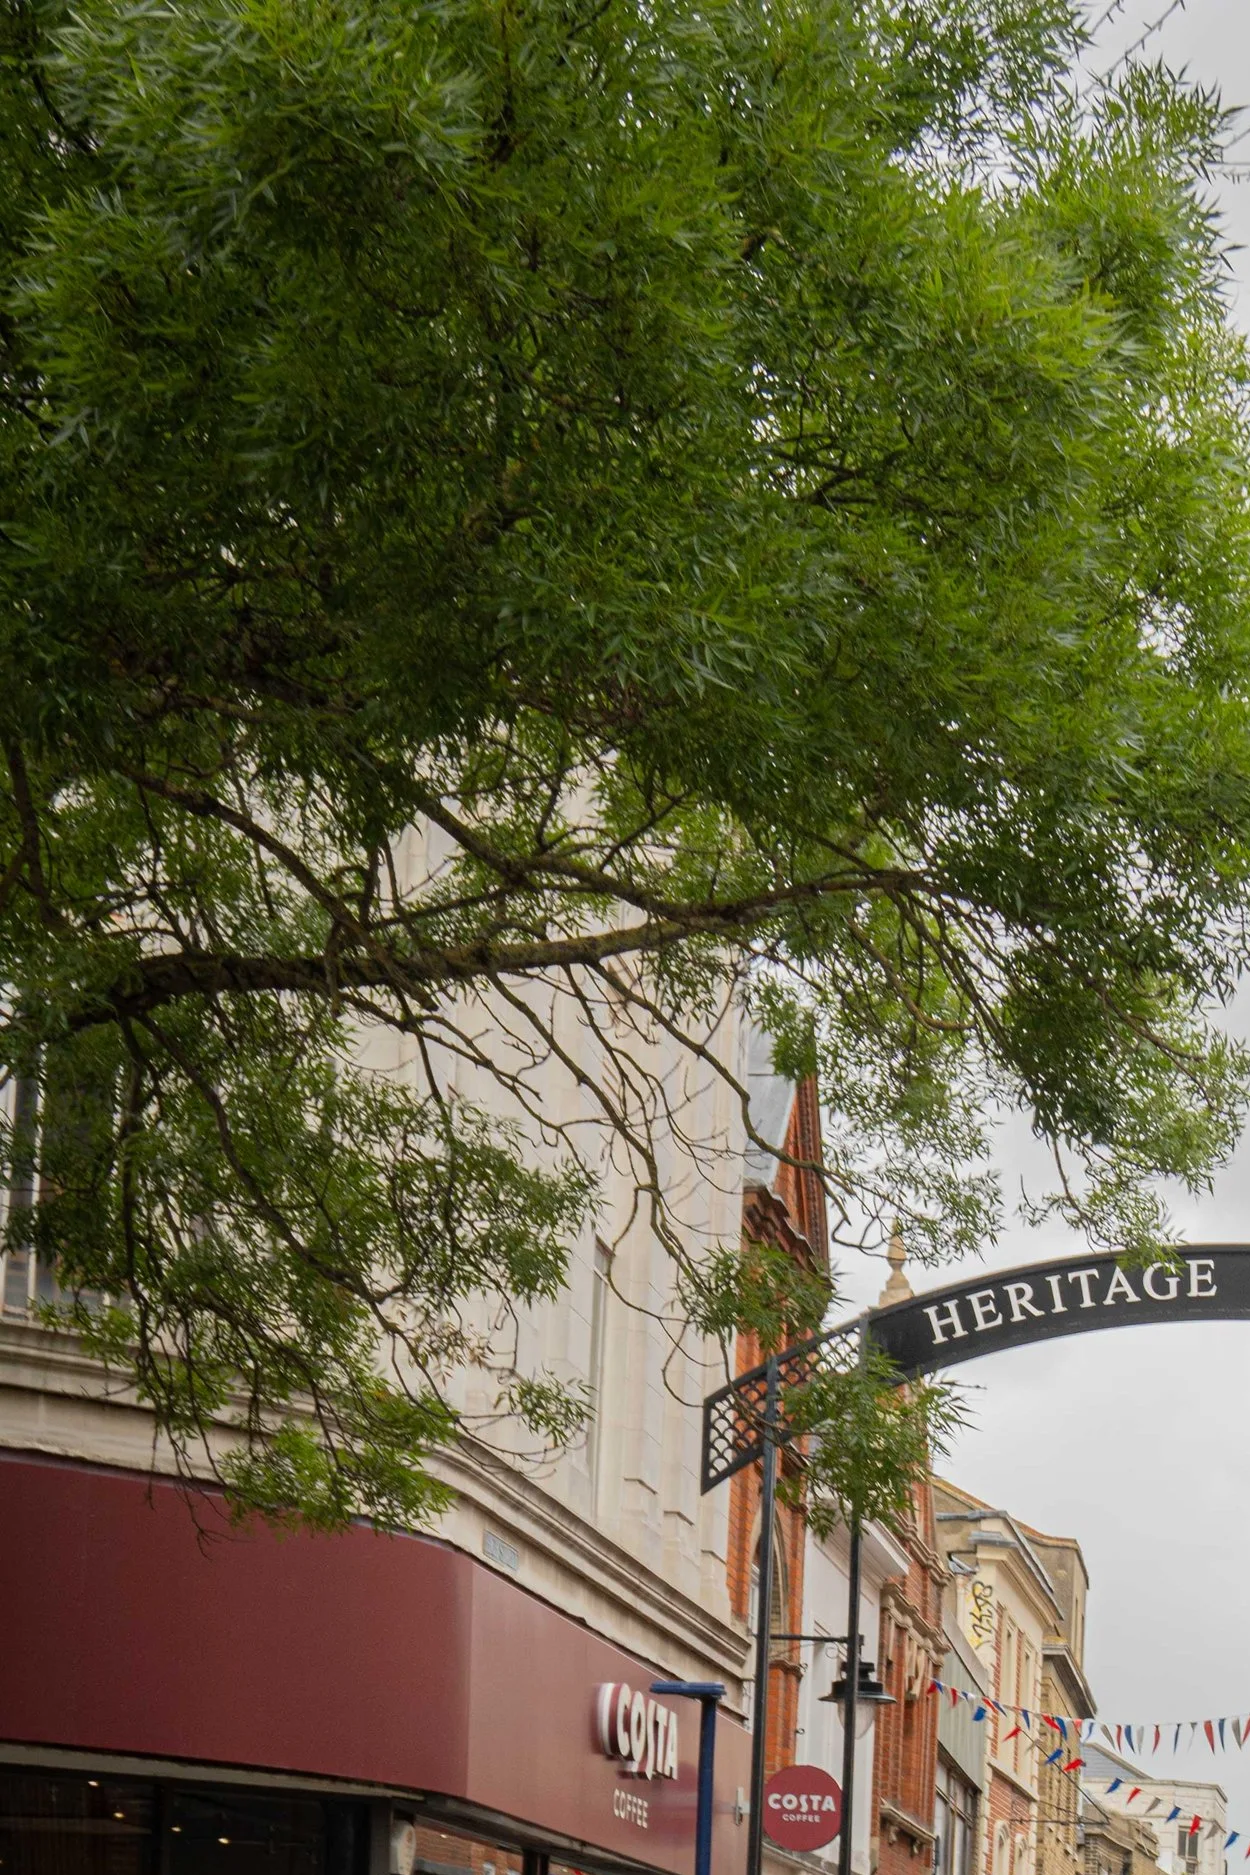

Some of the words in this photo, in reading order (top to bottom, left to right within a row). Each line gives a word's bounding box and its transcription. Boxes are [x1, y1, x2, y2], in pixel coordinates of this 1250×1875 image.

[923, 1258, 1217, 1345] HERITAGE
[611, 1683, 678, 1781] COSTA
[613, 1788, 649, 1829] COFFEE
[767, 1793, 836, 1813] COSTA
[782, 1813, 821, 1823] COFFEE
